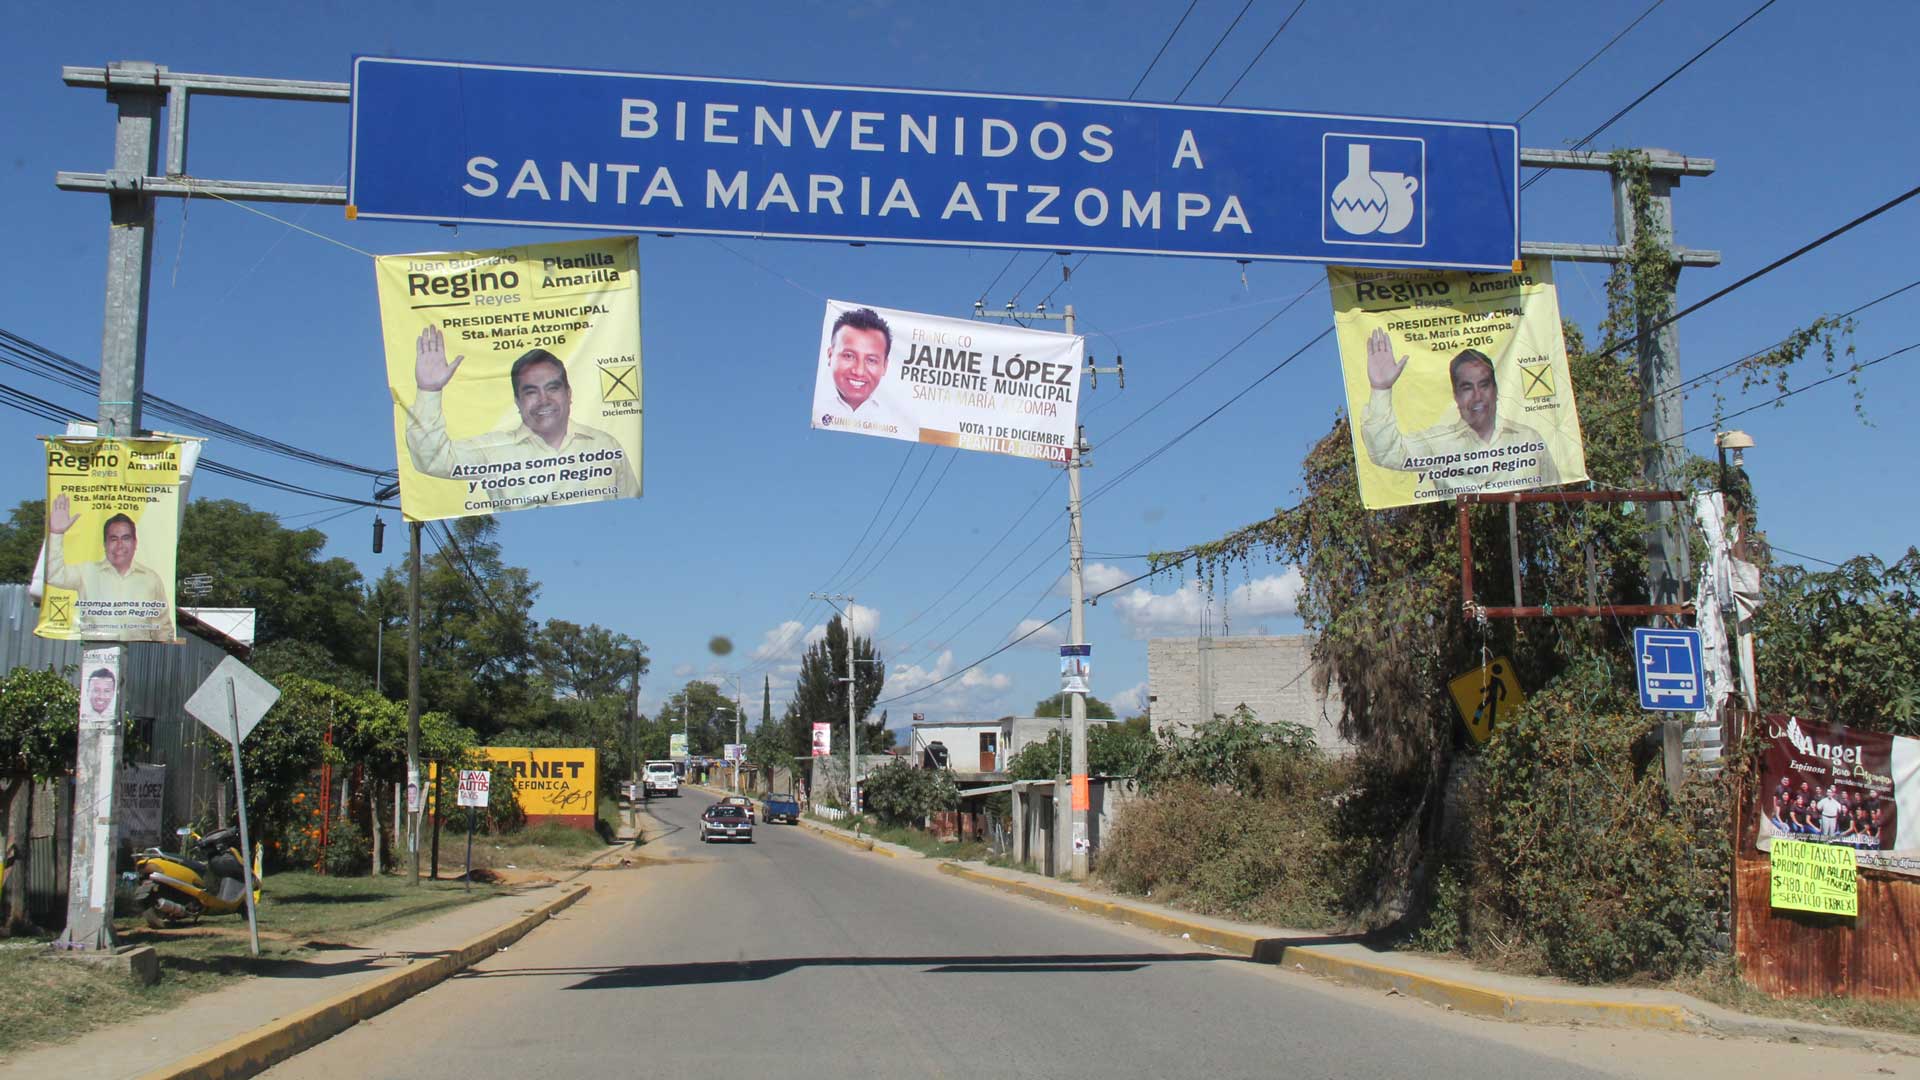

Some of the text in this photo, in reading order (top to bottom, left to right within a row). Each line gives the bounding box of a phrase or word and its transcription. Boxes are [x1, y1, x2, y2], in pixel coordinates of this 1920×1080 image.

[621, 97, 1204, 169] BIENVENIDOS A
[462, 156, 1253, 235] SANTA MARIA ATZOMPA
[407, 260, 445, 273] Juan
[542, 252, 615, 272] Planilla
[408, 268, 520, 298] Regino
[541, 268, 621, 289] Amarilla
[1468, 274, 1533, 295] Amarilla
[475, 293, 521, 307] Reyes
[1356, 280, 1450, 303] Regino
[442, 305, 610, 329] PRESIDENTE MUNICIPAL
[1387, 307, 1525, 332] PRESIDENTE MUNCIPAL
[461, 320, 594, 340] Sta. María Atzompa.
[1404, 322, 1514, 343] Sta. María Atzompa.
[493, 338, 524, 351] 2014
[534, 334, 567, 348] 2016
[1431, 341, 1458, 352] 2014
[1466, 335, 1494, 348] 2016
[597, 354, 636, 366] Vota Así
[903, 343, 1073, 387] JAIME LÓPEZ
[900, 365, 1073, 403] PRESIDENTE MUNICIPAL
[959, 421, 985, 435] VOTA
[996, 426, 1009, 438] DE
[1011, 428, 1065, 446] DICIEMBRE
[48, 451, 119, 471] Regino
[127, 461, 178, 471] Amarilla
[452, 449, 623, 477] Atzompa somos todos
[1404, 442, 1545, 469] Atzompa somos todos
[468, 465, 613, 493] y todos con Regino
[1418, 457, 1537, 484] y todos con Regino
[61, 484, 173, 494] PRESIDENTE MUNICIPAL
[1414, 485, 1477, 500] Compromiso
[1485, 475, 1542, 491] Experiencia
[73, 494, 92, 502] Sta.
[117, 493, 160, 504] Atzompa.
[464, 486, 619, 512] Compromiso y Experiencia
[75, 600, 112, 609] Atzompa
[141, 600, 166, 608] todos
[128, 609, 160, 618] Regino
[459, 781, 489, 792] AUTOS
[460, 771, 487, 781] LAVA
[517, 780, 570, 790] EFONICA
[1773, 841, 1852, 866] AMIGO TAXISTA
[1773, 875, 1816, 895] $480.00
